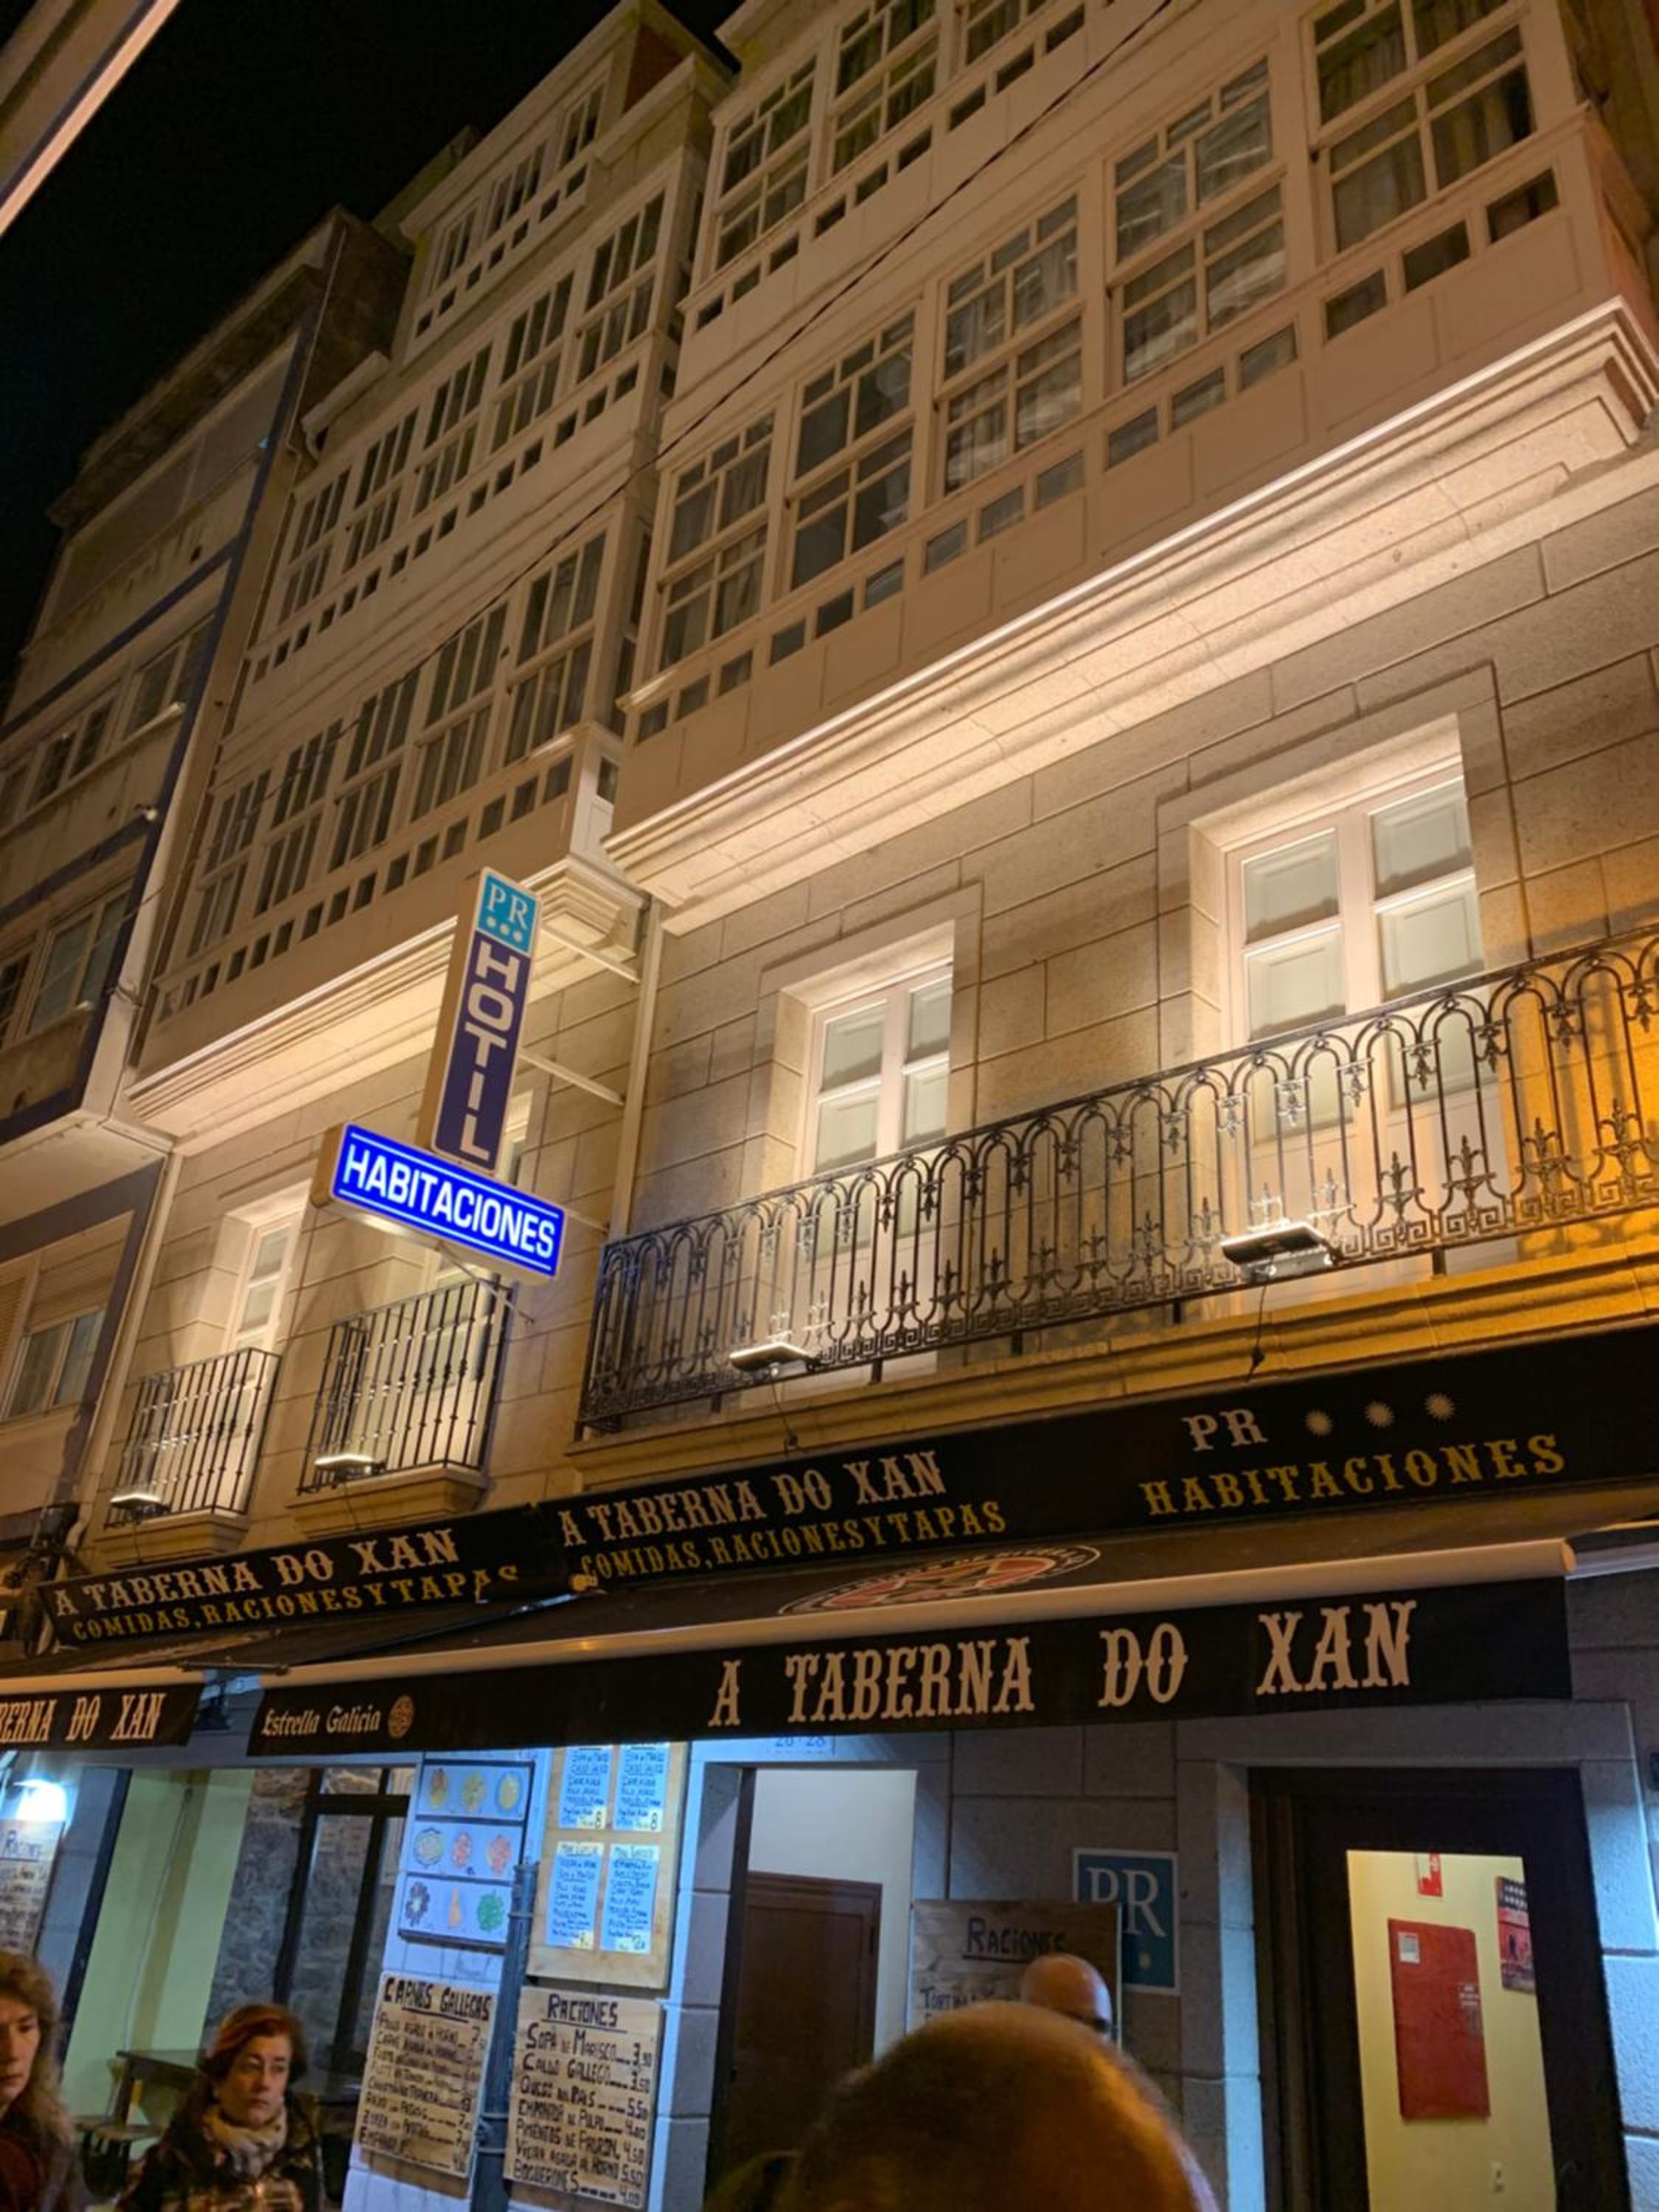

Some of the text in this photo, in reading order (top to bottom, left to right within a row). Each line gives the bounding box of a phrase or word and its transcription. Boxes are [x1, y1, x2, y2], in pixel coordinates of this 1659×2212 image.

[486, 883, 530, 931] PR
[341, 1143, 557, 1260] HABITACIONES
[1181, 1408, 1269, 1453] PR
[557, 1450, 948, 1548] A TABERNA DO XAN
[1138, 1433, 1566, 1517] HABITACIONES
[54, 1527, 460, 1618] A TABERNA DO XAN
[707, 1600, 1417, 1728] A TABERNA DO XAN
[65, 1696, 101, 1742] DO
[109, 1692, 167, 1742] XAN
[261, 1704, 382, 1738] Estrella Galicia
[1086, 1866, 1167, 1938] PR
[525, 2022, 557, 2050] SOPA
[547, 1993, 619, 2028] RACIONES
